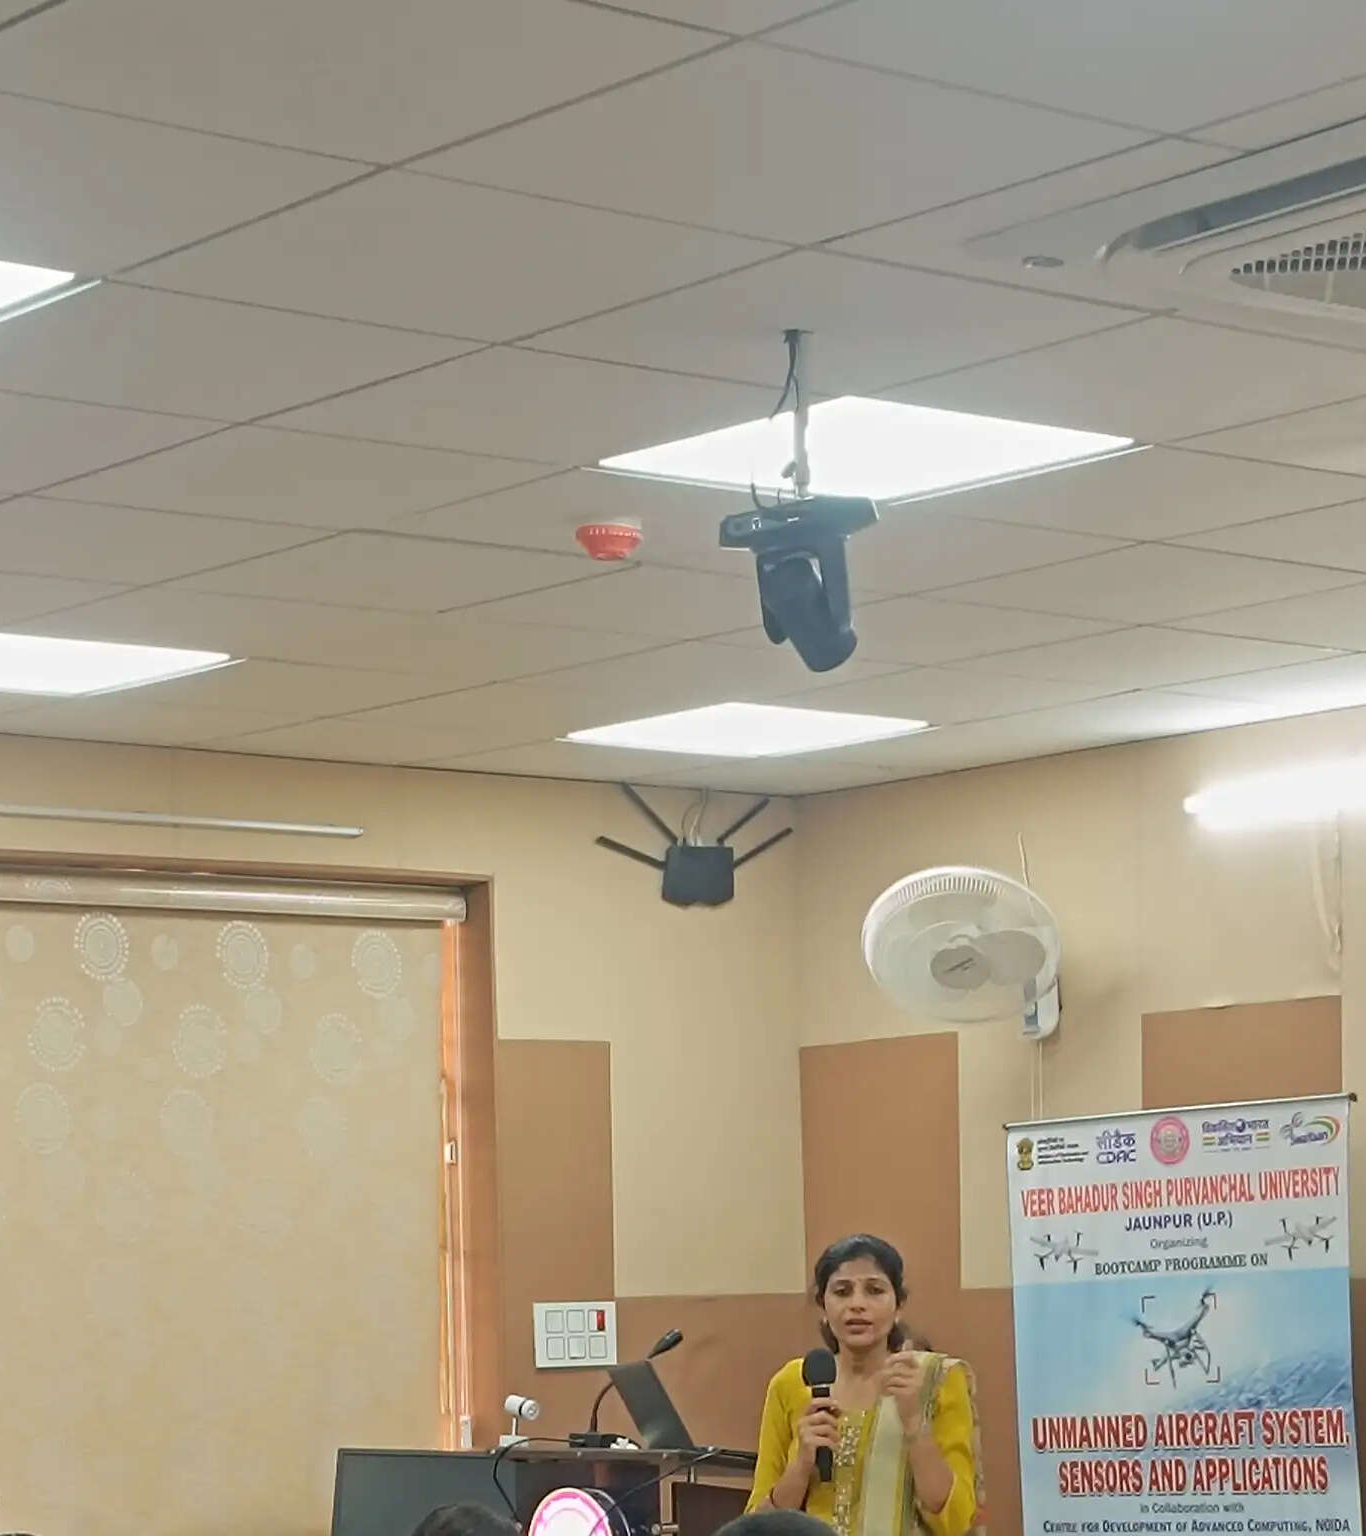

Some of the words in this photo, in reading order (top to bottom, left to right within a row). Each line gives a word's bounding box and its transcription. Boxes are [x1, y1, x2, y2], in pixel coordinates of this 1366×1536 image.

[1096, 1149, 1136, 1165] CDAC
[1021, 1187, 1056, 1217] VEER
[1058, 1183, 1119, 1215] BAHADUR
[1122, 1177, 1163, 1210] SINGH
[1167, 1172, 1254, 1207] PURVANCHAL
[1258, 1166, 1340, 1201] UNIVERSITY
[1125, 1212, 1193, 1232] JAUNPUR
[1197, 1211, 1233, 1230] (U.P.)
[1150, 1237, 1208, 1250] Organizing
[1095, 1259, 1161, 1276] BOOTCAMP
[1165, 1254, 1247, 1272] PROGRAMME
[1251, 1253, 1268, 1267] ON
[1032, 1414, 1148, 1450] UNMANNED
[1154, 1411, 1255, 1449] AIRCRAFT
[1261, 1409, 1350, 1447] SYSTEM,
[1058, 1459, 1144, 1495] SENSORS
[1148, 1458, 1187, 1494] AND
[1192, 1456, 1329, 1493] APPLICATIONS
[1152, 1502, 1220, 1514] Collaboration
[1223, 1502, 1244, 1513] with
[1315, 1518, 1351, 1532] NOIDA
